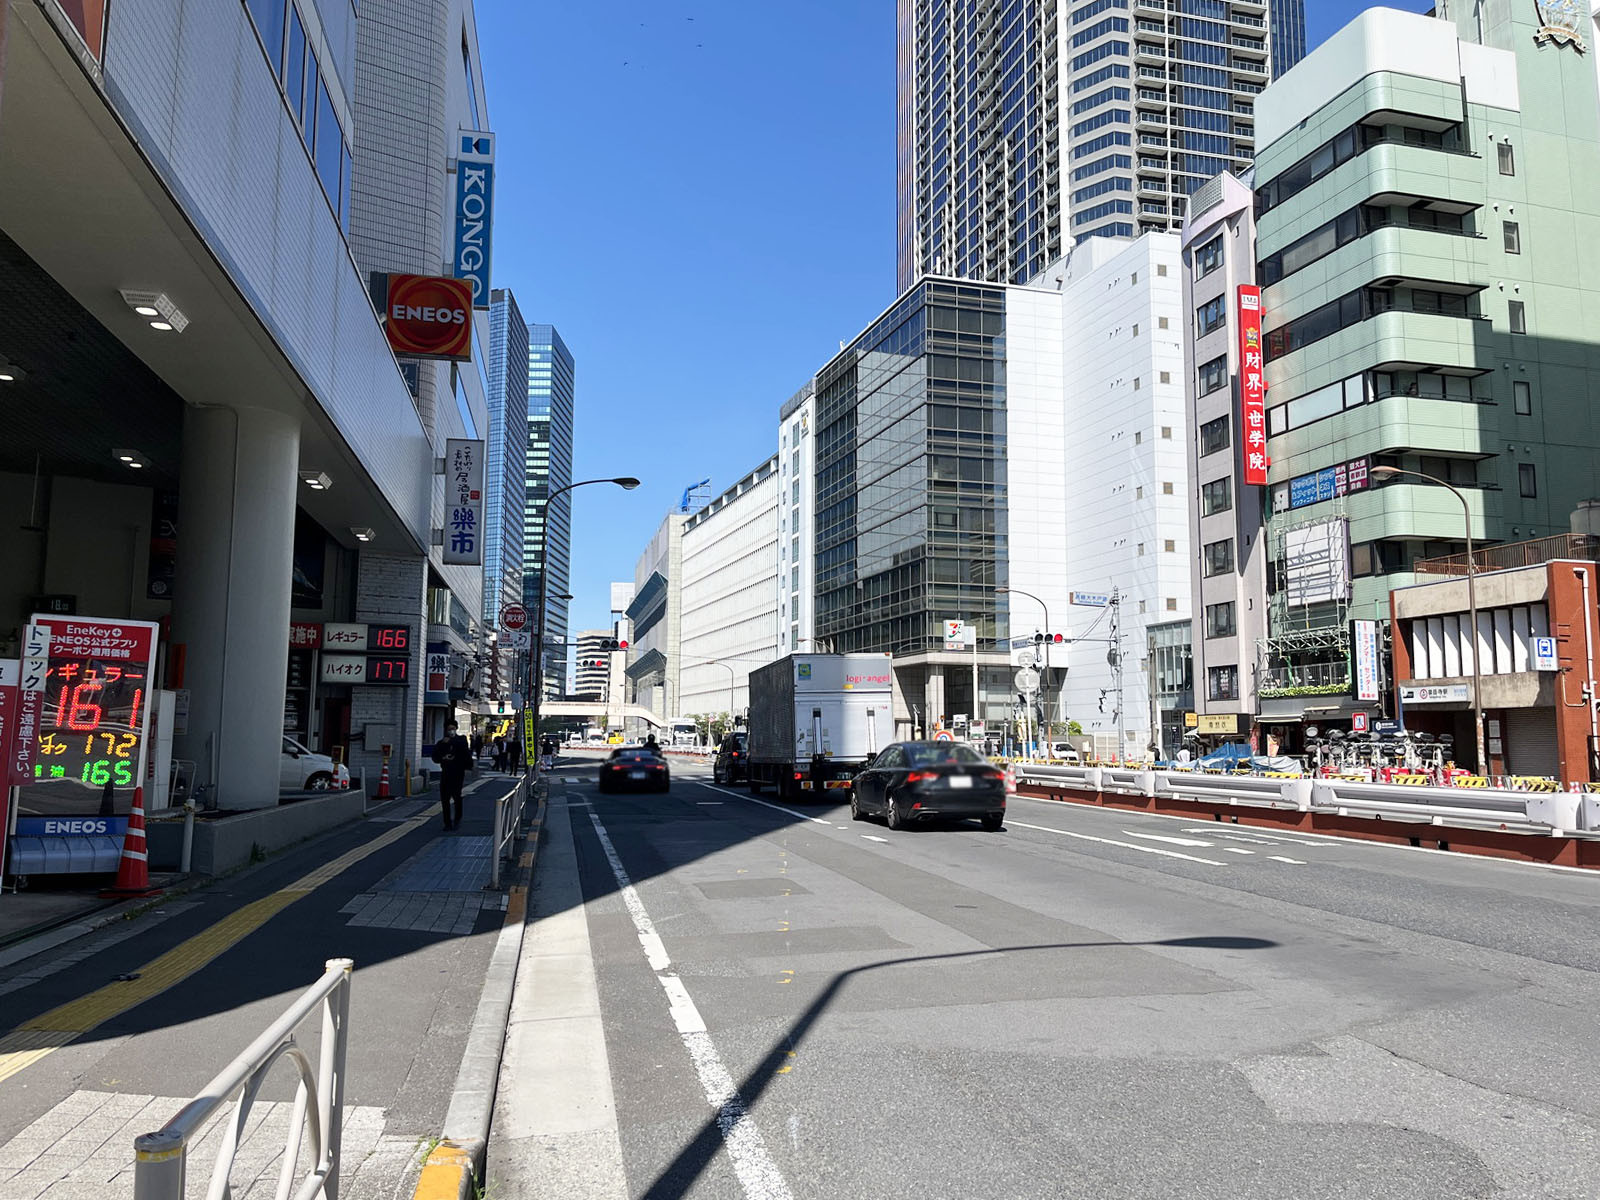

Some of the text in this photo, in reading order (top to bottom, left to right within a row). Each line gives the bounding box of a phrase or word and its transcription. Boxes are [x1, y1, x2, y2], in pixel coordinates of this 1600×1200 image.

[460, 167, 485, 299] KONGO
[392, 304, 465, 324] ENEOS
[1245, 352, 1266, 470] 財界二世学院
[67, 624, 111, 638] EneKey
[327, 629, 406, 648] レギュラー 166
[51, 635, 138, 648] ENEOS公式アプリ
[54, 645, 131, 658] クーポン適用価格
[326, 661, 406, 679] ハイオク 177
[56, 684, 142, 730] 161
[85, 732, 137, 757] 172
[81, 760, 132, 785] 165
[45, 820, 107, 834] ENEOS
